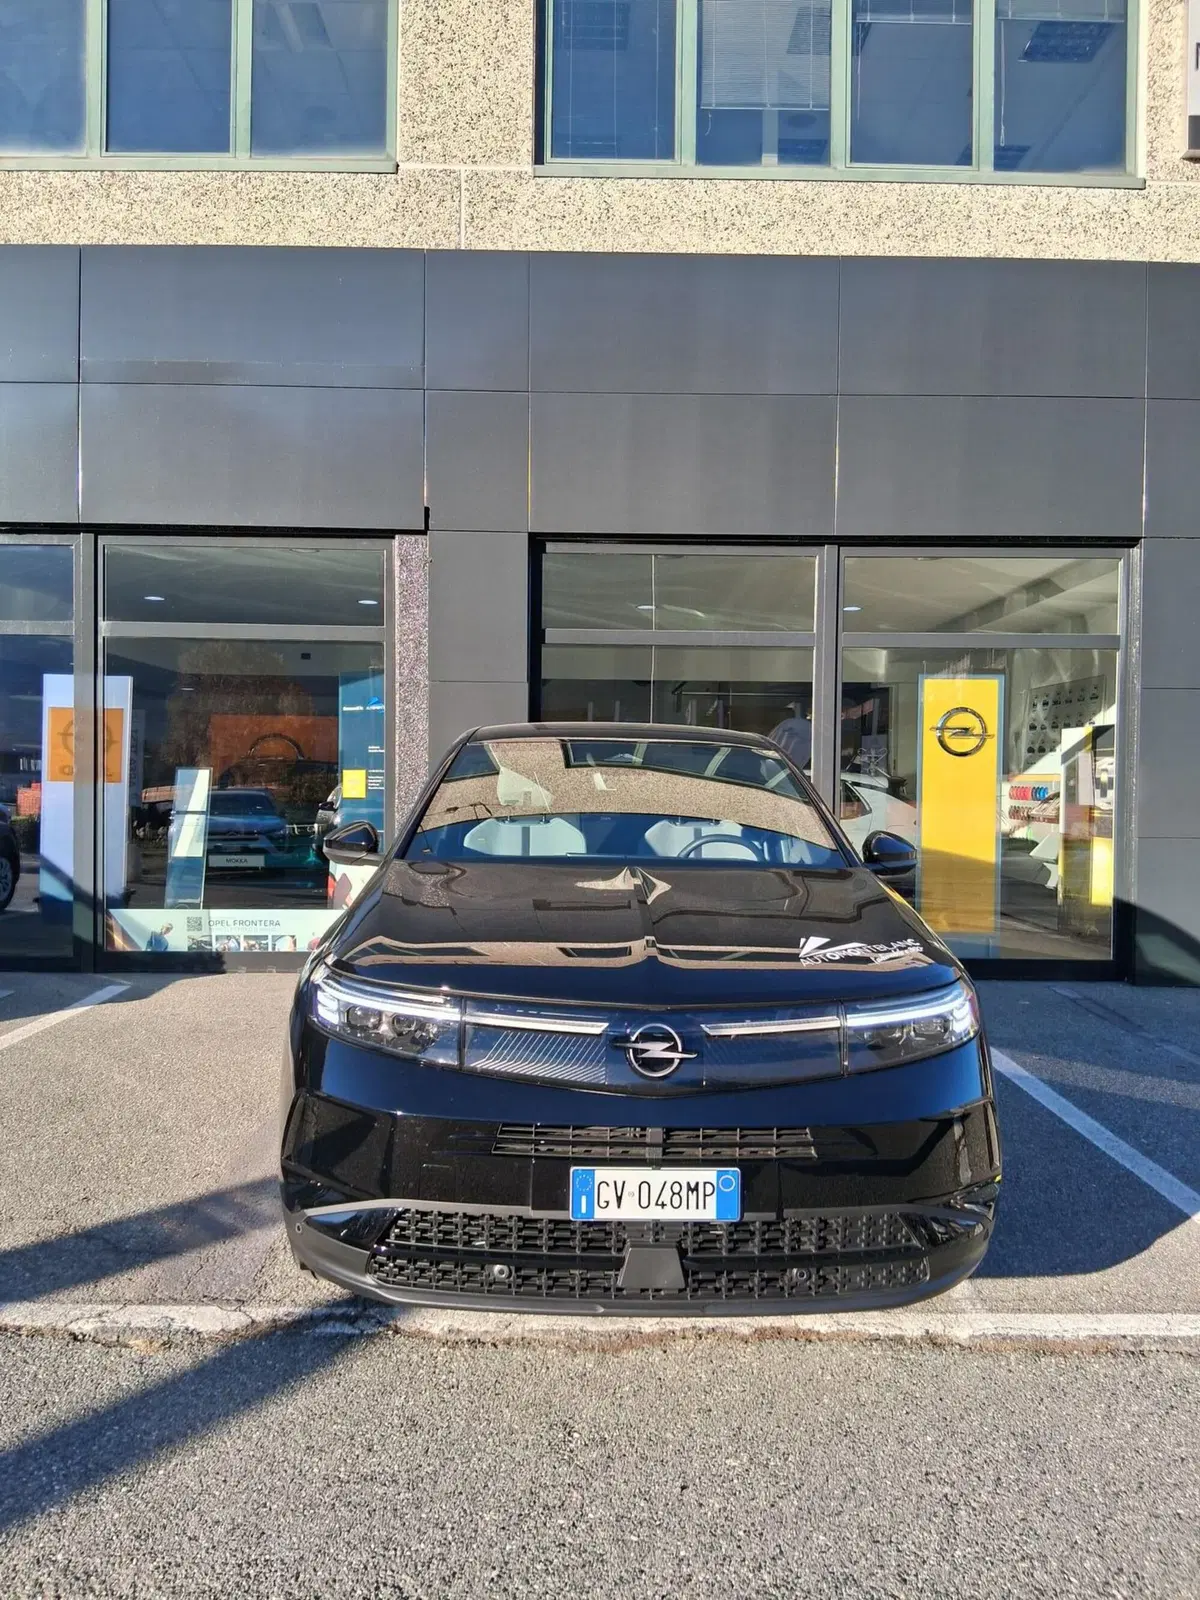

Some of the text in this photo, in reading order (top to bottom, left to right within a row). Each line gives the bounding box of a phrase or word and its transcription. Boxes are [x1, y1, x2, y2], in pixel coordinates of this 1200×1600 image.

[208, 919, 281, 927] OPEL FRONTERA
[800, 938, 920, 967] AUTOMONTBLANC
[597, 1180, 626, 1210] GV
[638, 1180, 716, 1210] 048MP
